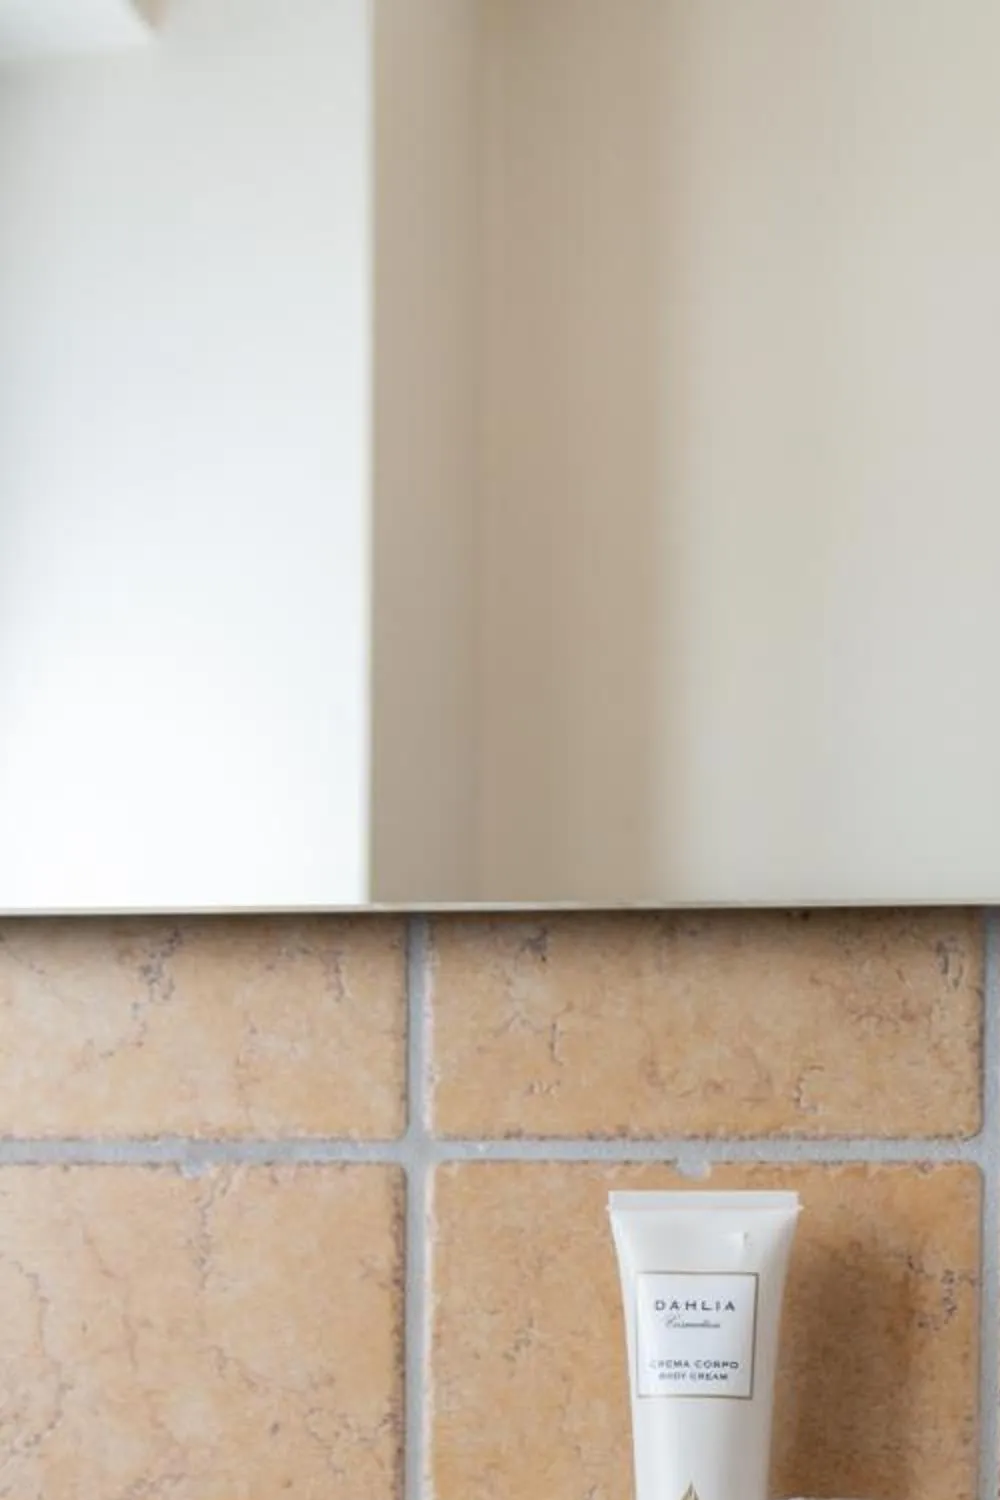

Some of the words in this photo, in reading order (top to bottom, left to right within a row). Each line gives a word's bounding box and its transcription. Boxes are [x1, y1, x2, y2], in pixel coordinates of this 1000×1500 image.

[654, 1299, 736, 1311] DAHLIA
[693, 1359, 740, 1370] CORPO
[688, 1371, 729, 1381] CREAM
